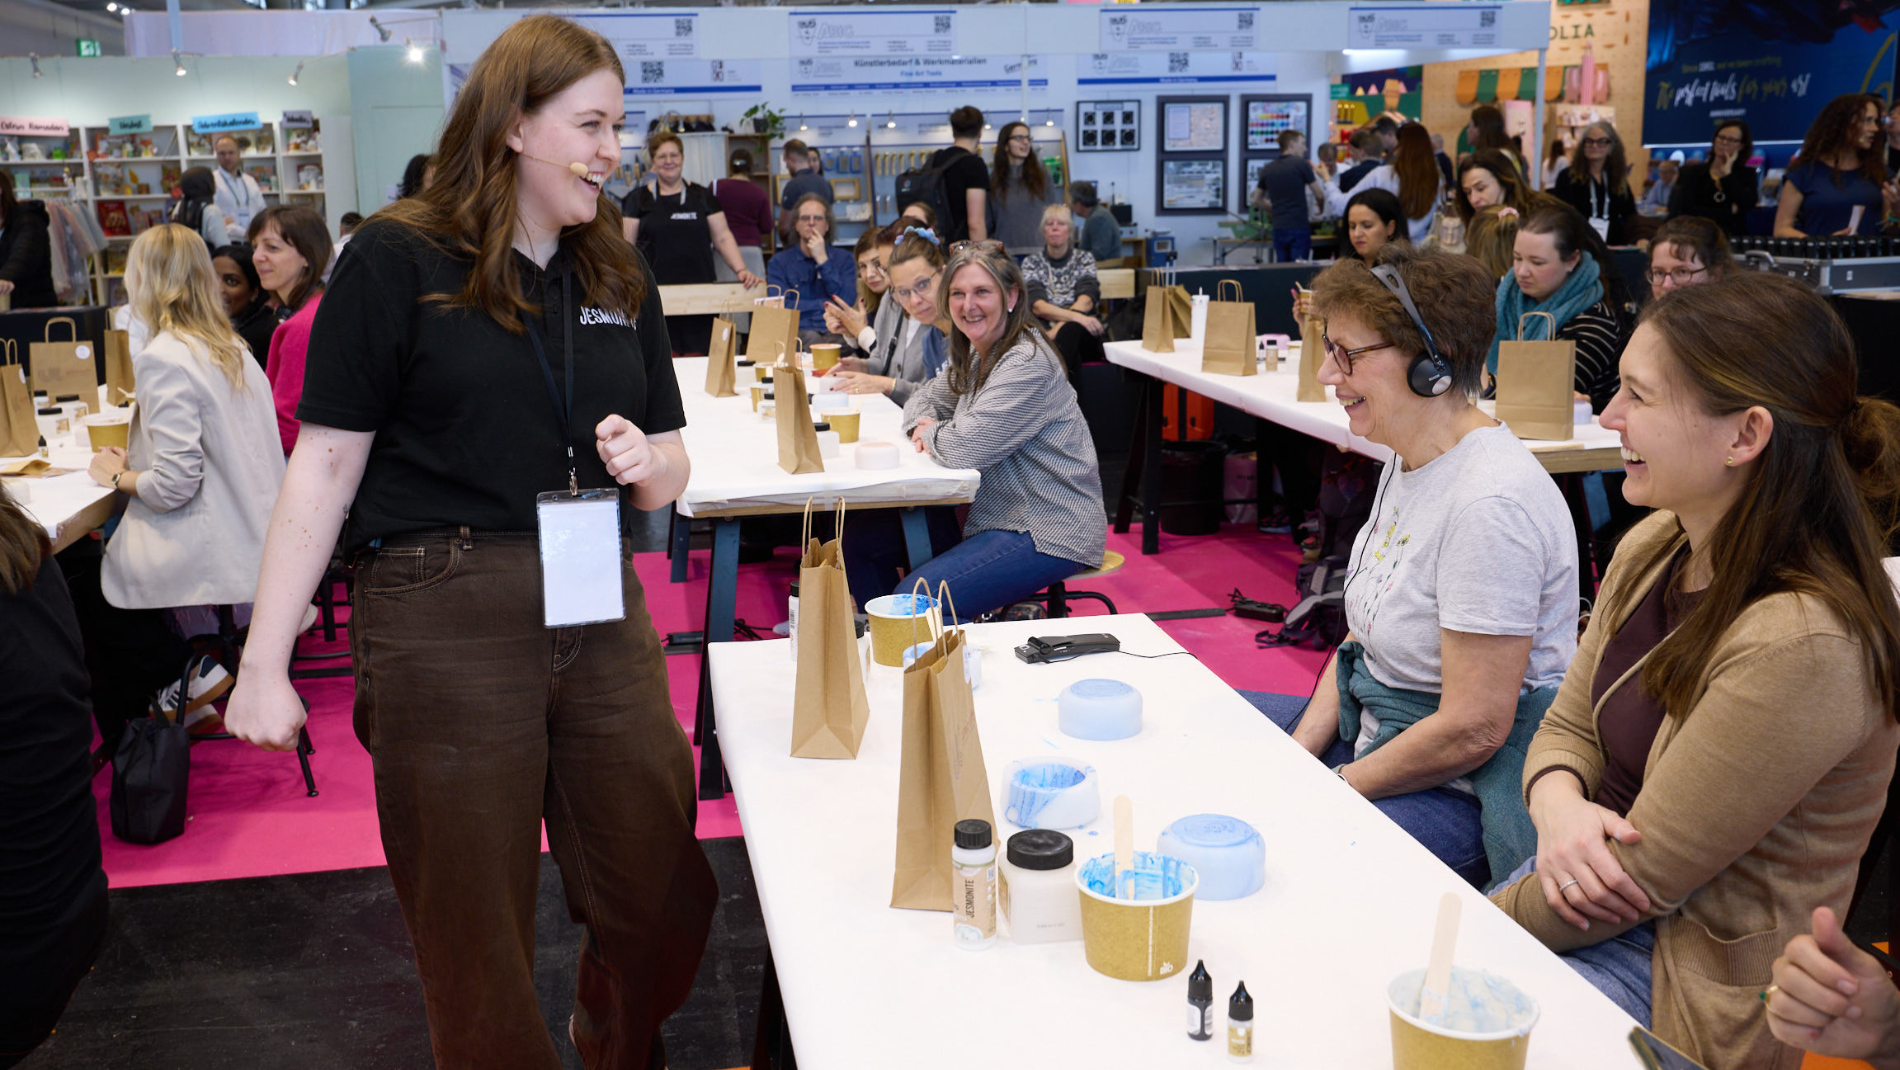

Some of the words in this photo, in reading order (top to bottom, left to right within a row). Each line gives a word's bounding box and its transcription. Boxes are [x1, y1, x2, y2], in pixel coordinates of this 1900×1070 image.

[854, 58, 913, 67] Künstlerbedarf
[923, 57, 987, 66] Werkmaterialien
[579, 305, 637, 331] JESMONE
[965, 878, 975, 918] JESMONITE
